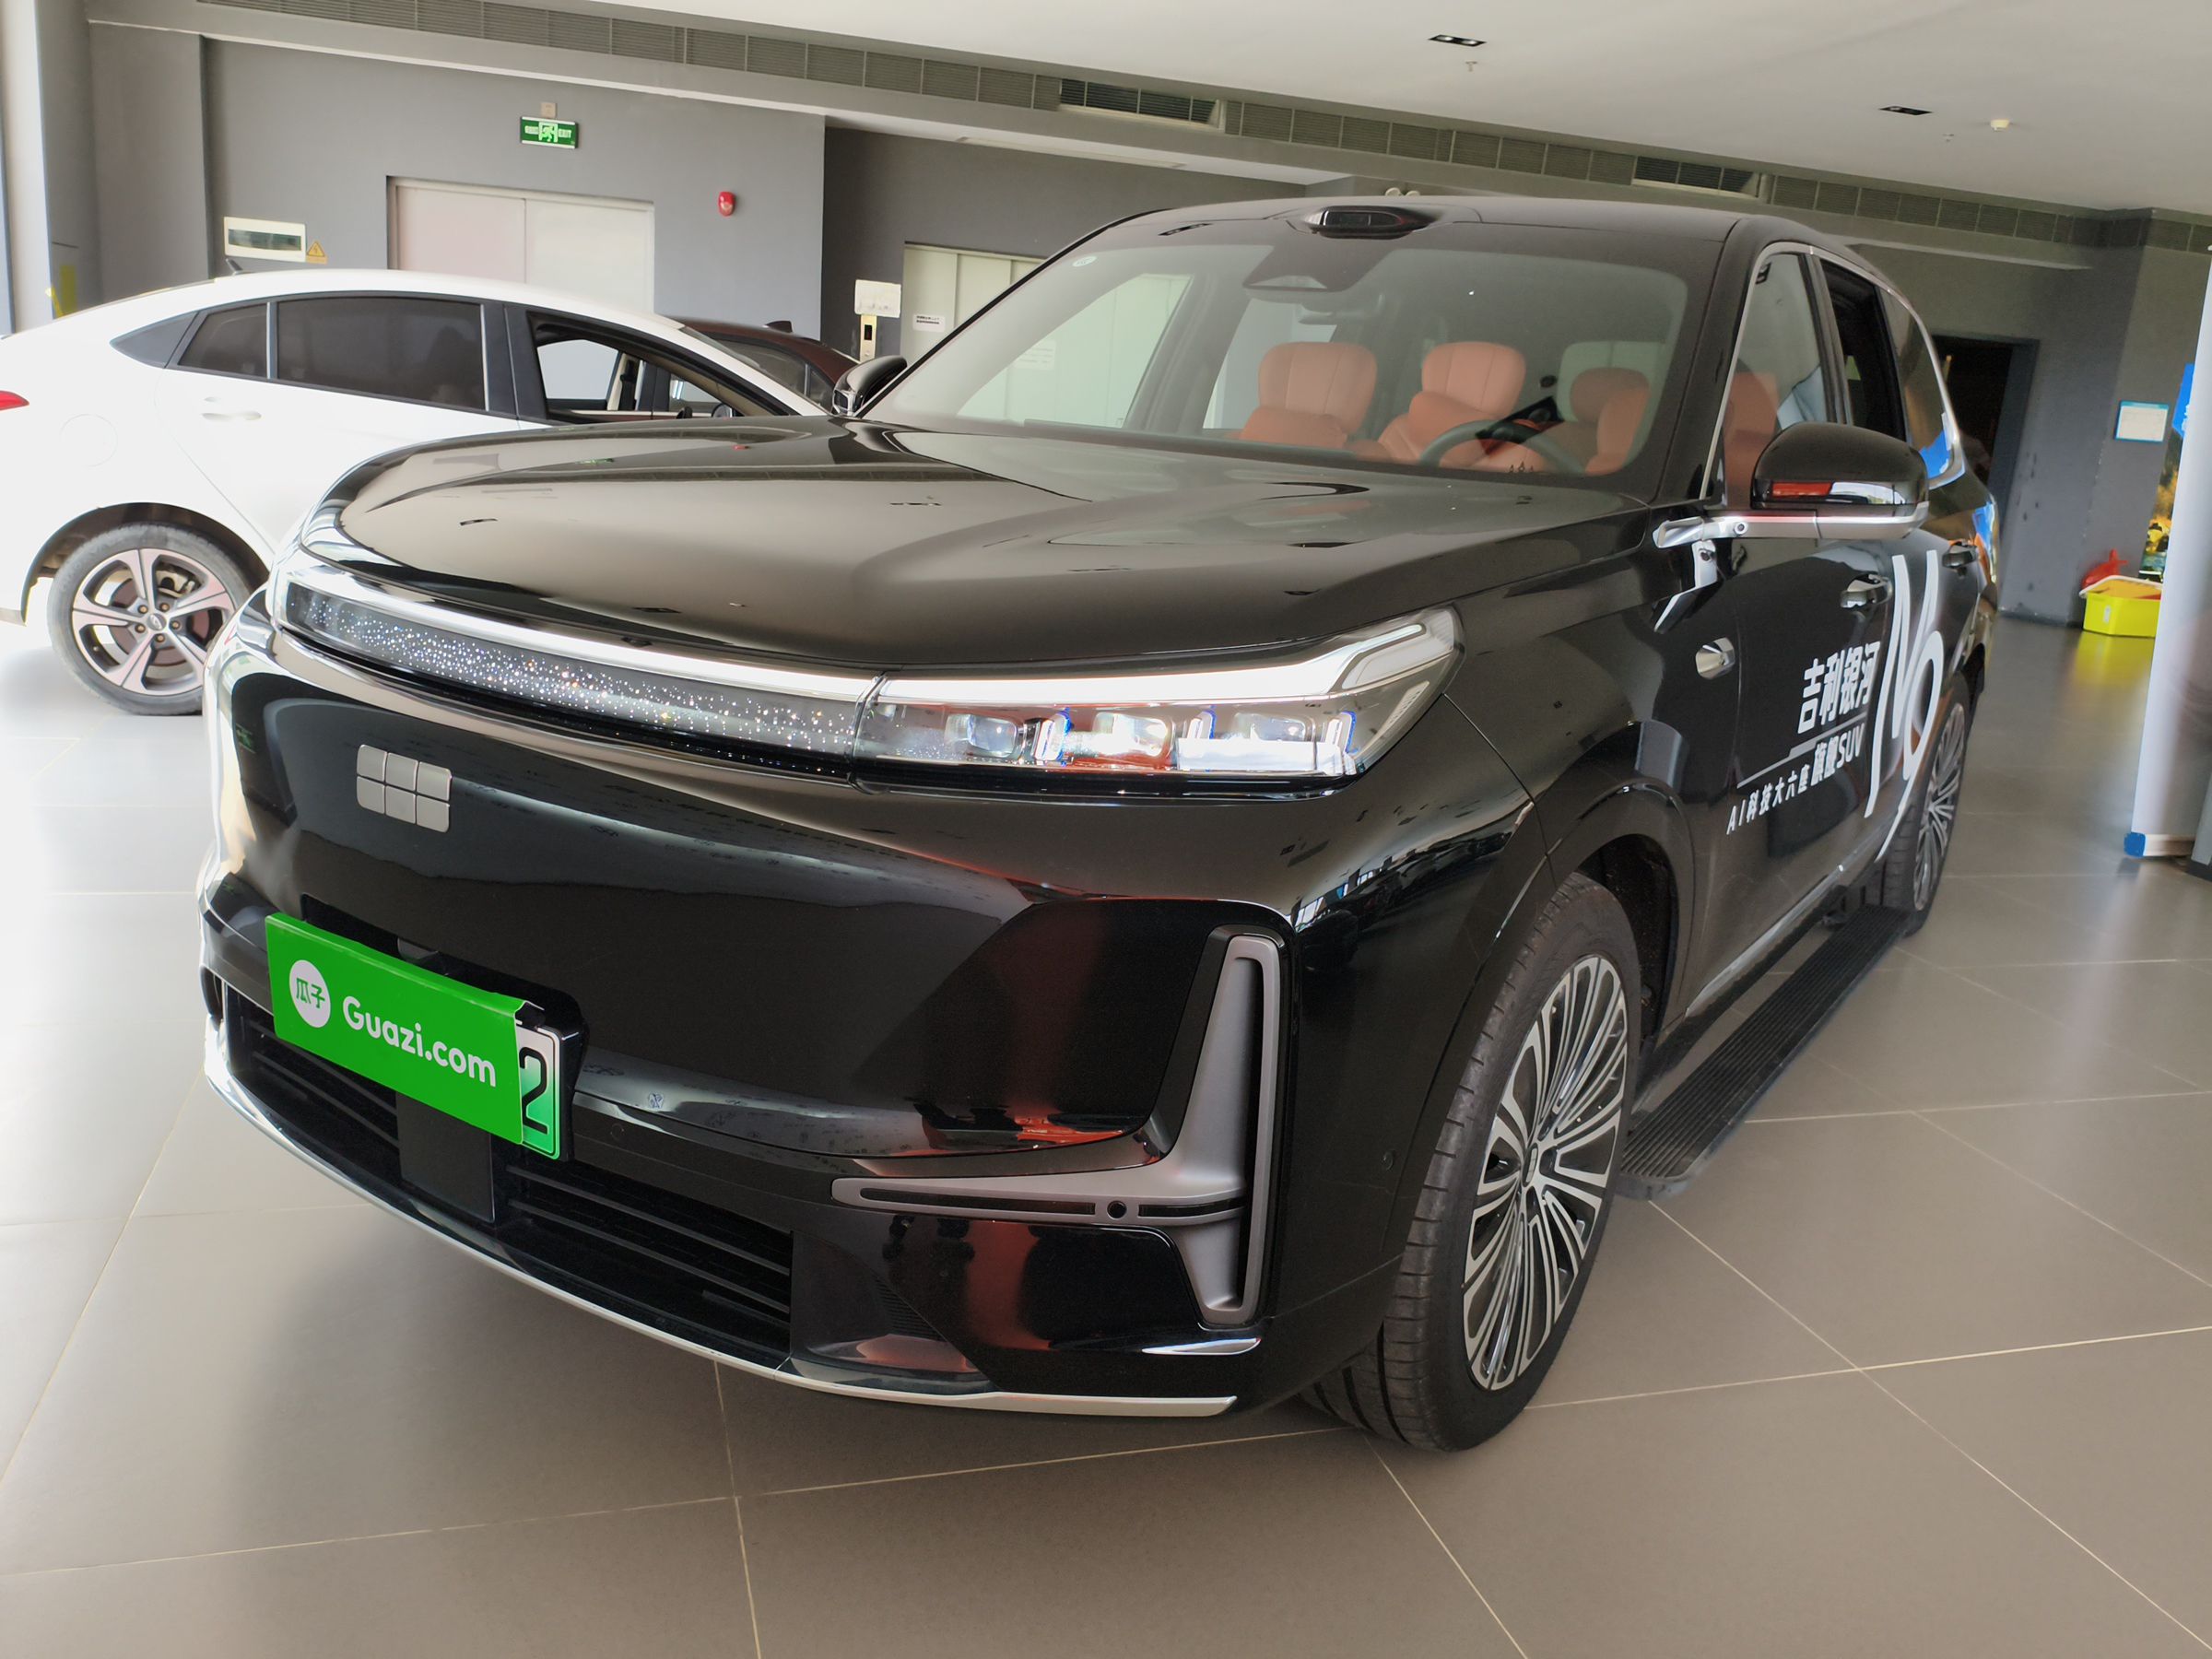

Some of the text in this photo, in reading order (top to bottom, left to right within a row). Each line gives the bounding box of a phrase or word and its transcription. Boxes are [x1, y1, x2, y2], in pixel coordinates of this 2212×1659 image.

[1797, 641, 1881, 735] 吉利银河
[295, 977, 497, 1088] 瓜子 Guazi.com
